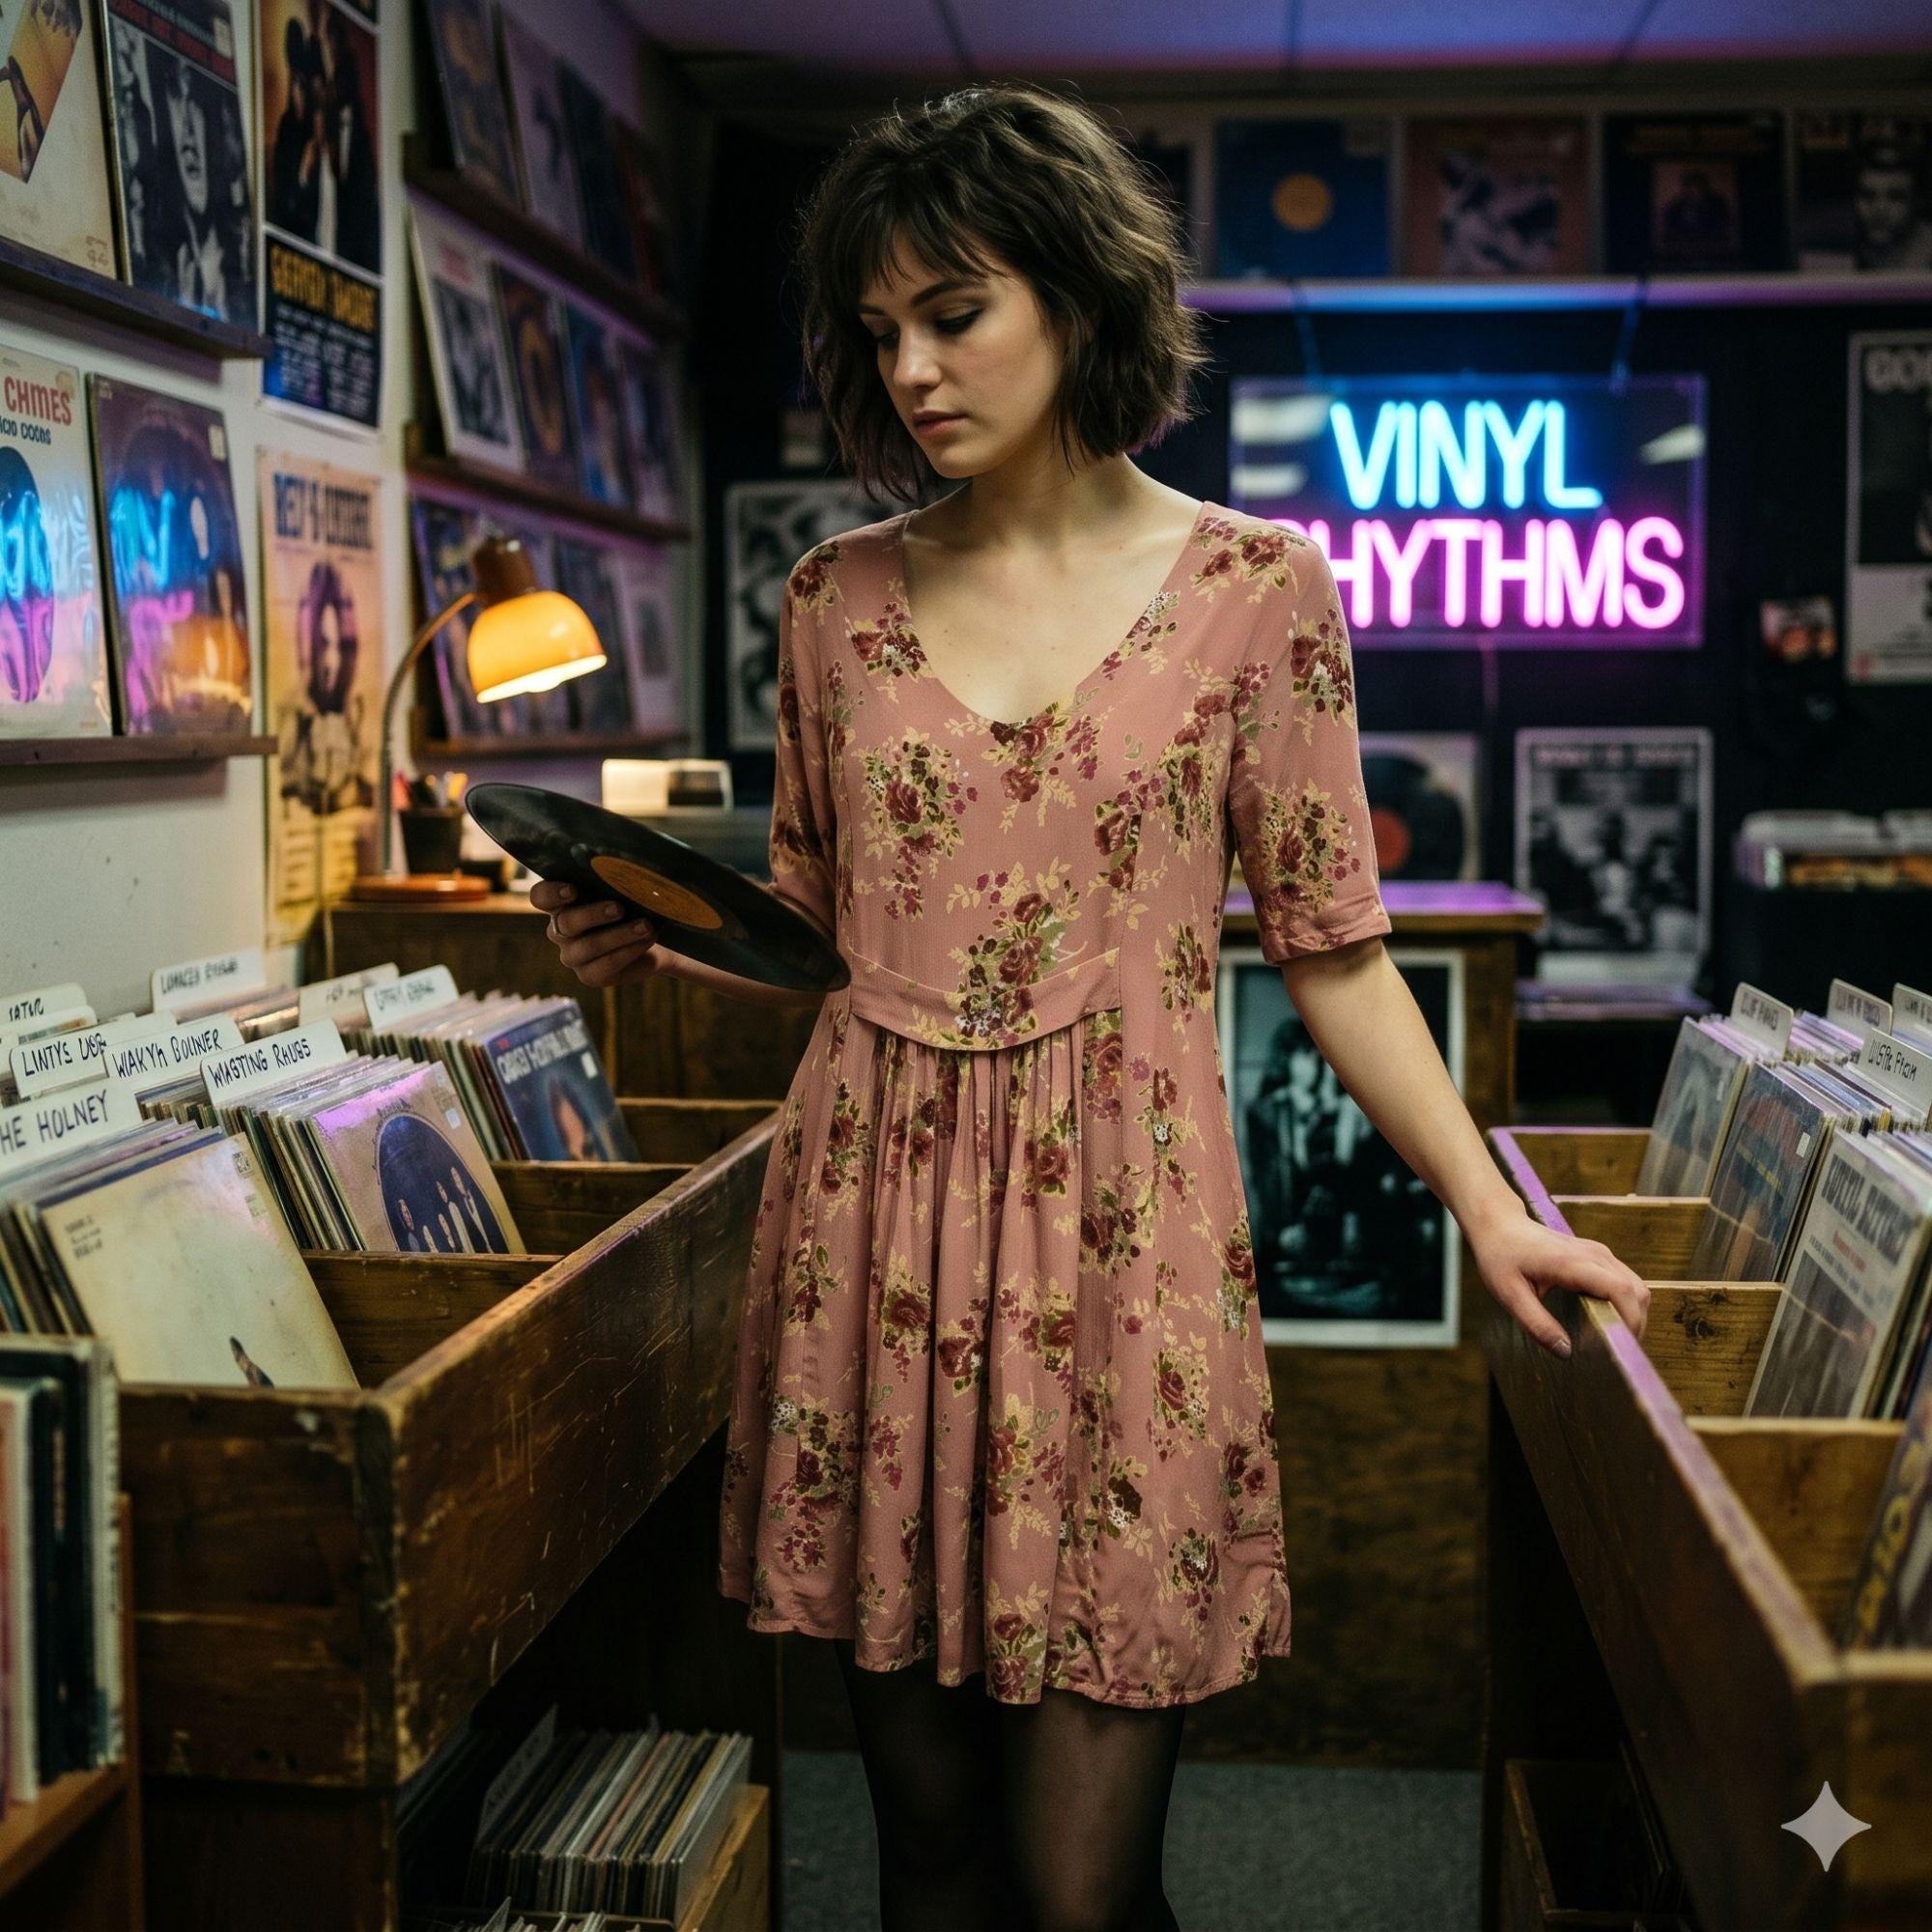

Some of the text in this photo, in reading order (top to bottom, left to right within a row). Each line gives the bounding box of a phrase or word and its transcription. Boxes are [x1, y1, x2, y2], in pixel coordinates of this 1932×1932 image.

[1329, 400, 1604, 510] VINYL
[1271, 516, 1686, 630] HYTHMS
[36, 1089, 108, 1143] HOLNEY
